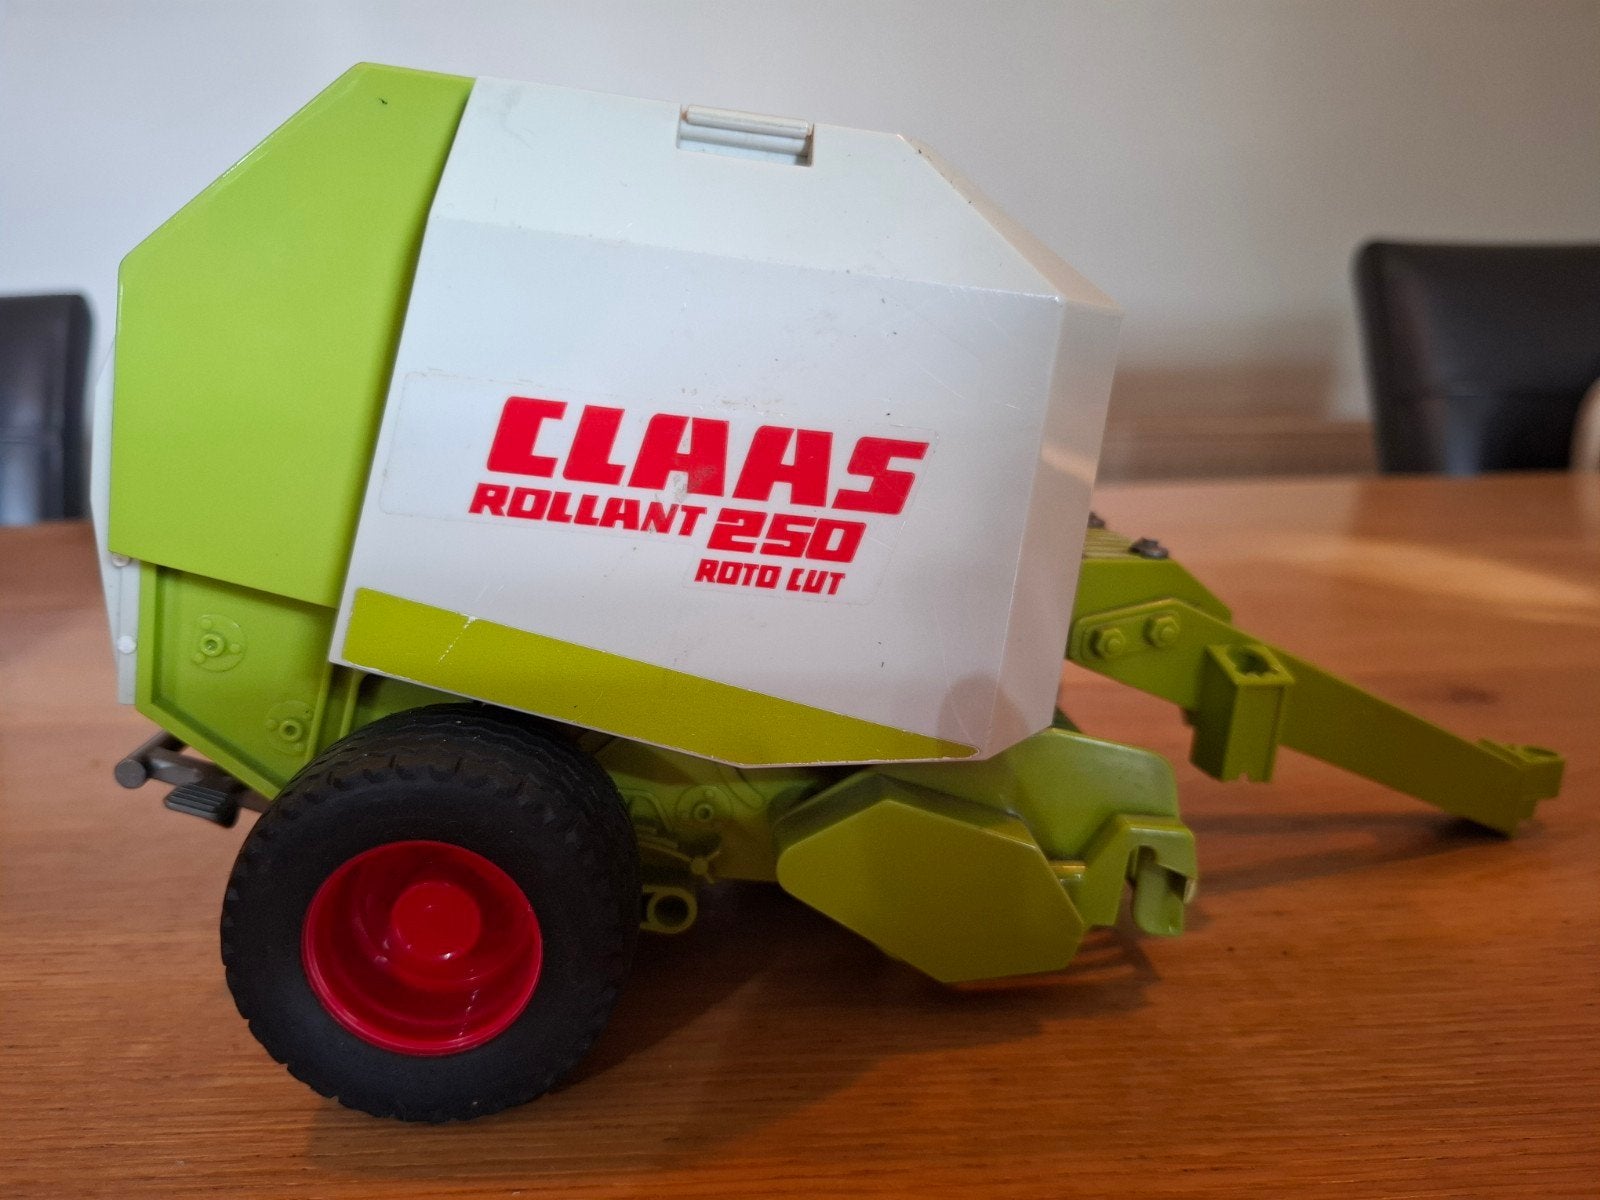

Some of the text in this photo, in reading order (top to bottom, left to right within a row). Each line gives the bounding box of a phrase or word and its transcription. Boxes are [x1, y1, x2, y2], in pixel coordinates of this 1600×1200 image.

[487, 396, 928, 515] CLAAS
[469, 483, 867, 563] ROLLANT 250
[694, 559, 845, 595] ROTO CUT
